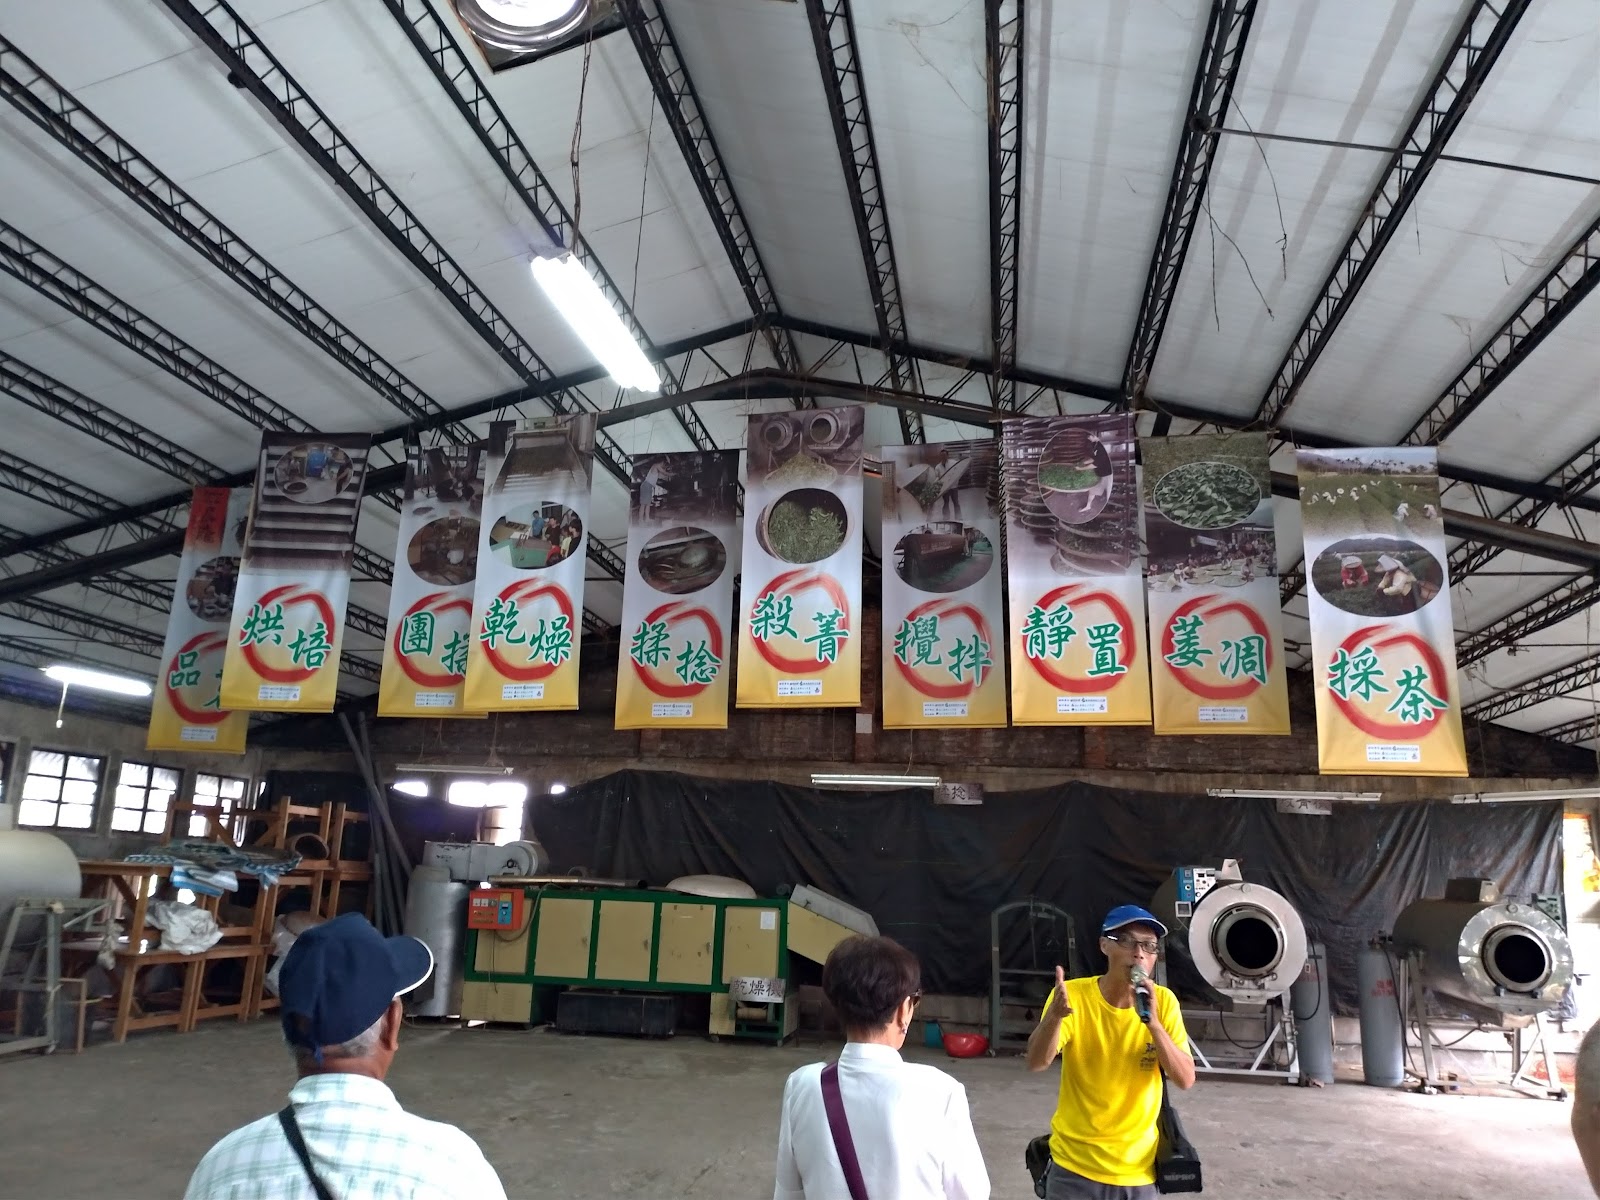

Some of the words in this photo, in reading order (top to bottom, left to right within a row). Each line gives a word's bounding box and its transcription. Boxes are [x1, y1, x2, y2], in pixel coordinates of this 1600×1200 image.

[241, 604, 331, 668] 烘培
[479, 598, 571, 664] 乾燥
[630, 622, 720, 685] 揉捻
[751, 593, 848, 661] 殺菁
[895, 616, 992, 685] 攪拌
[1022, 604, 1125, 676] 靜置
[1167, 615, 1266, 684] 萎凋
[1329, 646, 1448, 723] 採茶
